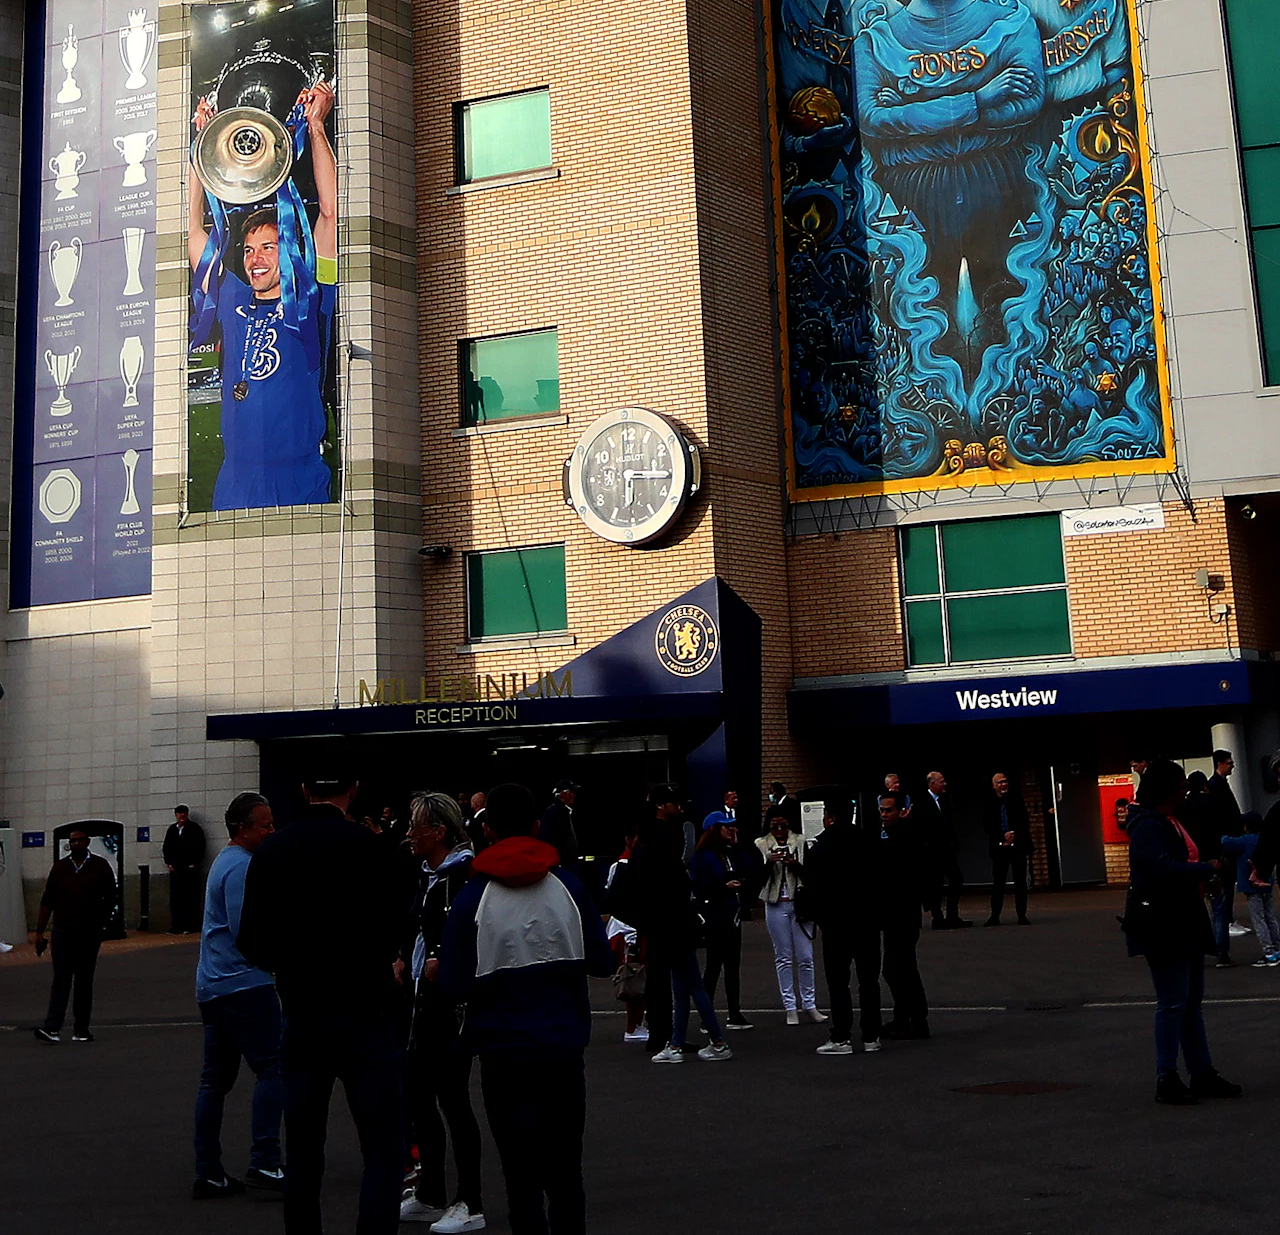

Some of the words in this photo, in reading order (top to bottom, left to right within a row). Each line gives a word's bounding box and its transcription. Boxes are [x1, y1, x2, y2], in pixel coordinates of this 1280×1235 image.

[787, 19, 853, 66] WEISZ
[1043, 8, 1111, 67] HIRSCH
[908, 46, 987, 79] JONES
[115, 96, 137, 106] PREMIER
[137, 92, 157, 101] LEAGUE
[119, 194, 138, 202] LEAGUE
[139, 191, 150, 199] CUP
[130, 301, 150, 310] EUROPA
[56, 311, 85, 321] CHAMPIONS
[122, 309, 143, 318] LEAGUE
[54, 320, 74, 328] LEAGUE
[117, 422, 133, 430] SUPER
[134, 420, 146, 428] CUP
[621, 427, 636, 442] 12
[595, 450, 610, 464] 10
[616, 453, 645, 464] HUBLOT
[1101, 443, 1163, 460] SOUZA
[115, 530, 133, 538] WORLD
[35, 538, 65, 547] COMMUNITY
[66, 536, 84, 544] SHIELD
[665, 608, 706, 625] CHELSEA
[359, 670, 573, 706] MILLENNIUM
[956, 687, 1058, 711] Westview
[415, 705, 517, 725] RECEPTION
